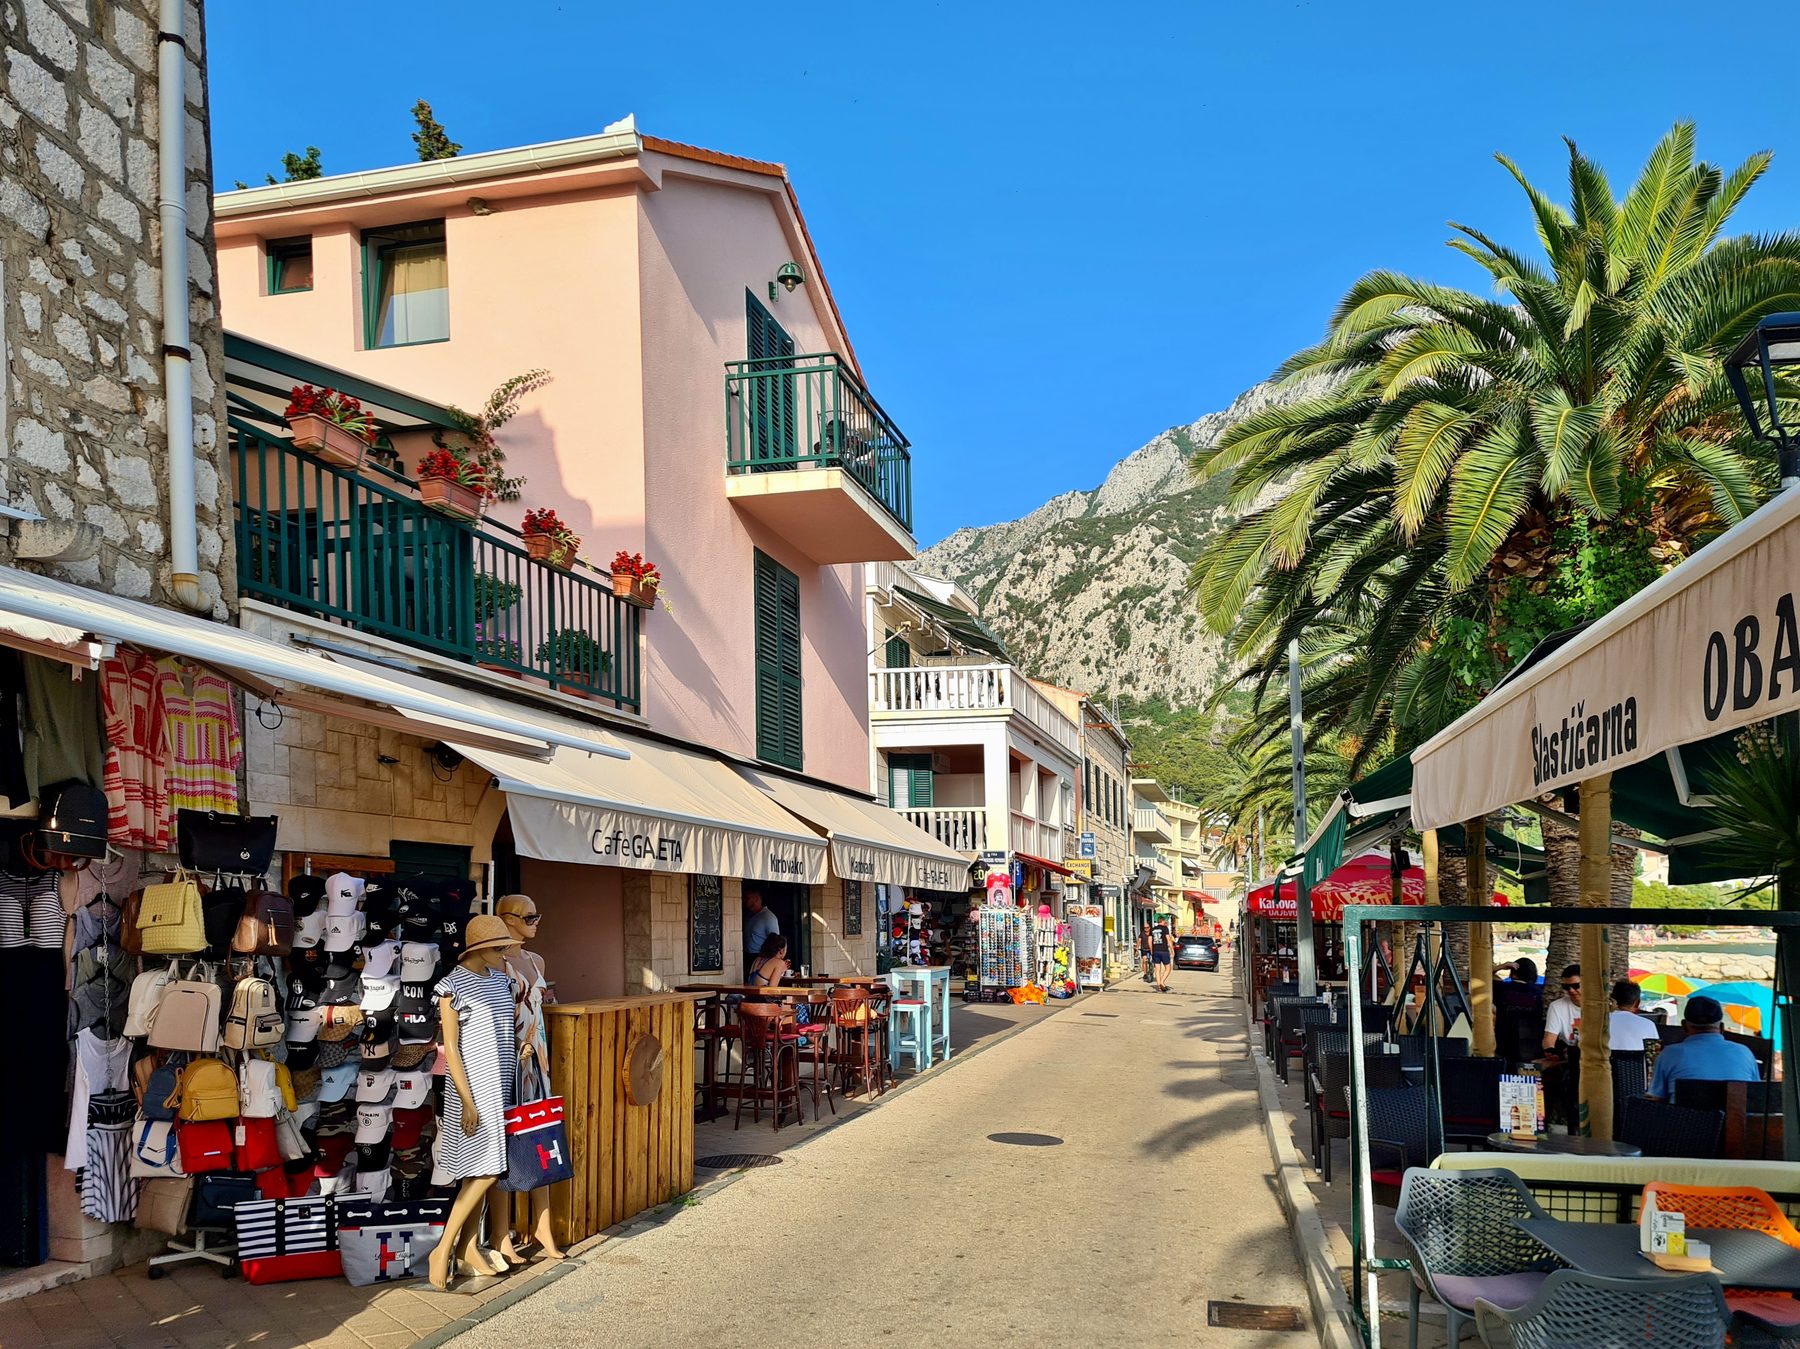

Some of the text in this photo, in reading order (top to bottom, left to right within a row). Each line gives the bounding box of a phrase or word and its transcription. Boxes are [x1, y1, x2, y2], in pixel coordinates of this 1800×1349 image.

[1531, 592, 1800, 787] Slastičarna OBA
[402, 1013, 427, 1024] FILA
